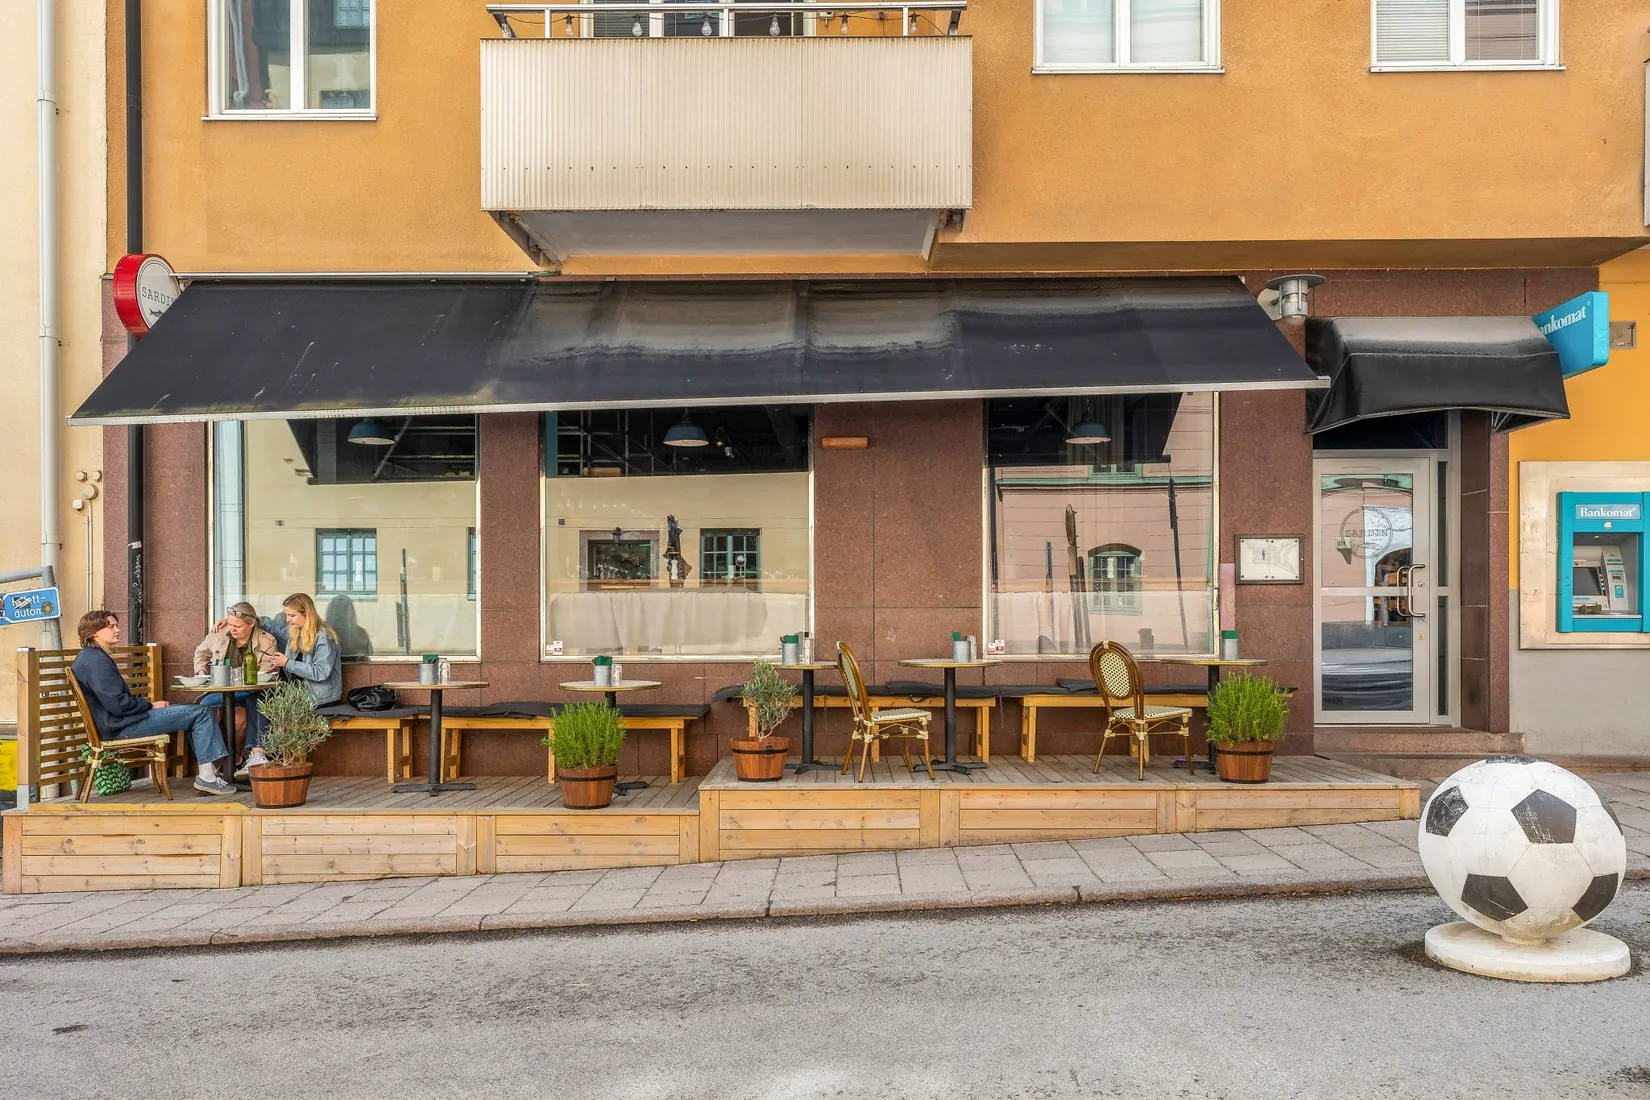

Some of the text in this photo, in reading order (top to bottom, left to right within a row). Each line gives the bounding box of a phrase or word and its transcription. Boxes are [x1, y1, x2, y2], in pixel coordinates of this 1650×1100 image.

[1580, 507, 1632, 517] Bankomat
[1345, 529, 1388, 537] SARDIN
[14, 607, 54, 618] autom
